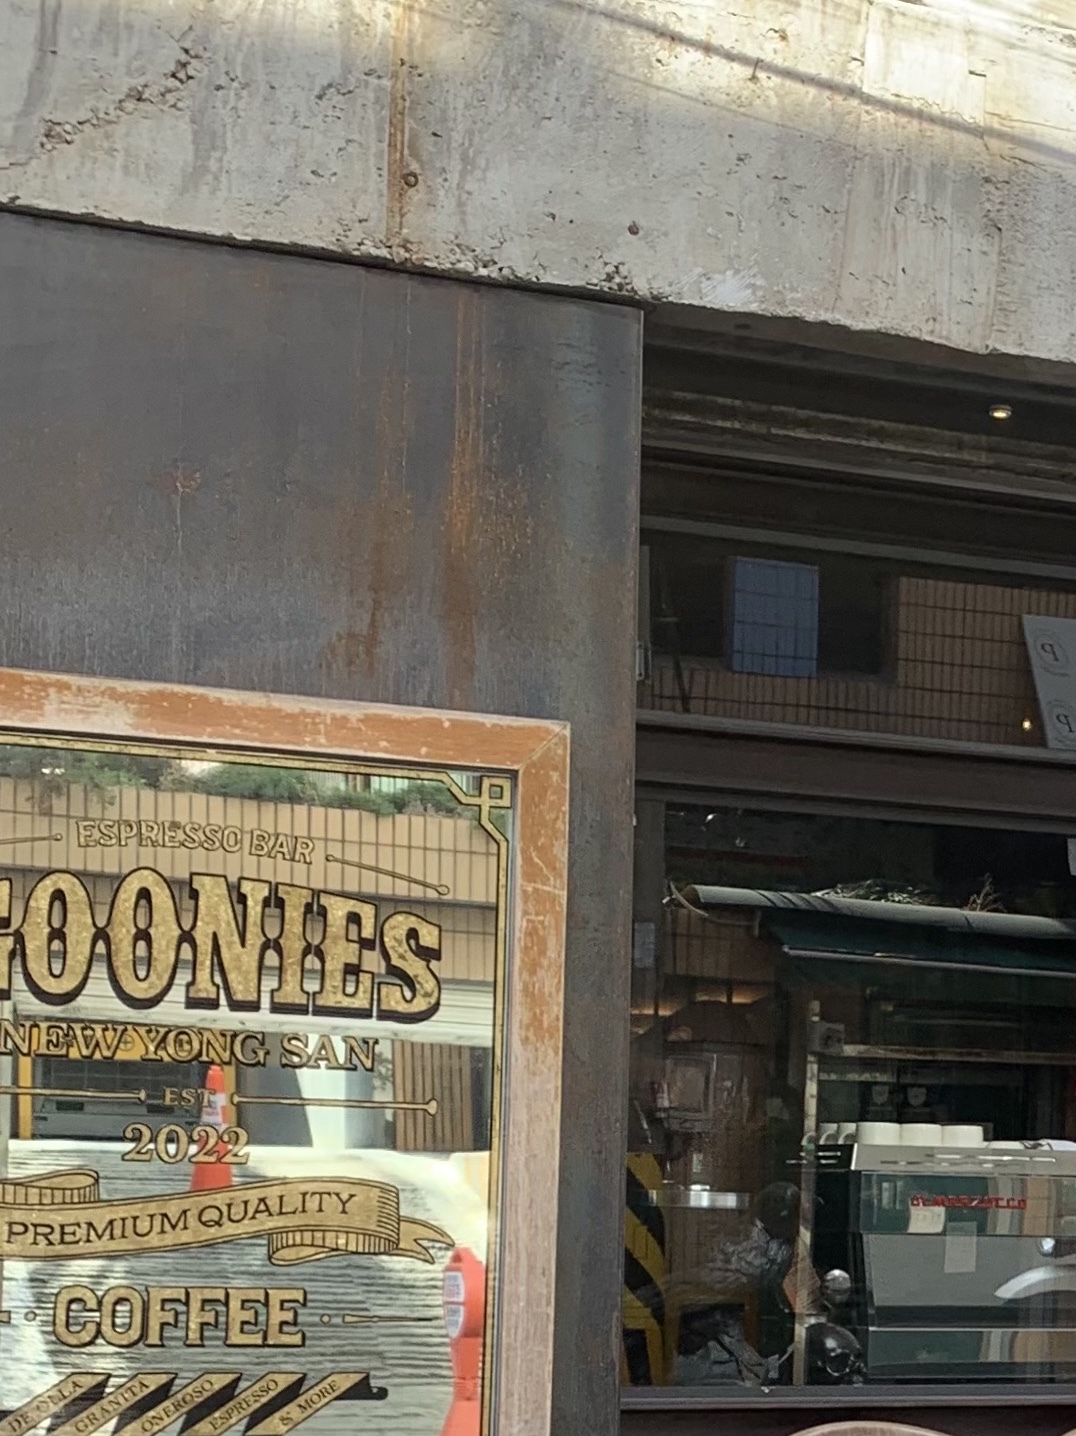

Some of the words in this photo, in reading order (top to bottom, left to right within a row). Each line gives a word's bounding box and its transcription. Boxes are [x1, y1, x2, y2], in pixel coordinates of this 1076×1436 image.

[76, 820, 243, 853] ESPRESSO
[249, 828, 315, 864] BAR
[0, 1018, 129, 1061] NEW
[134, 1024, 269, 1066] YONG
[280, 1032, 379, 1071] SAN
[163, 1087, 216, 1107] EST
[122, 1123, 250, 1164] 2022
[6, 1207, 190, 1247] PREMIUM
[197, 1190, 357, 1228] QUALITY
[53, 1285, 306, 1347] COFFEE
[7, 1411, 31, 1433] DE
[74, 1380, 150, 1434] GRANITA
[140, 1379, 214, 1434] ONEROSO
[208, 1378, 279, 1431] ESPRESSO
[299, 1379, 341, 1414] MORE
